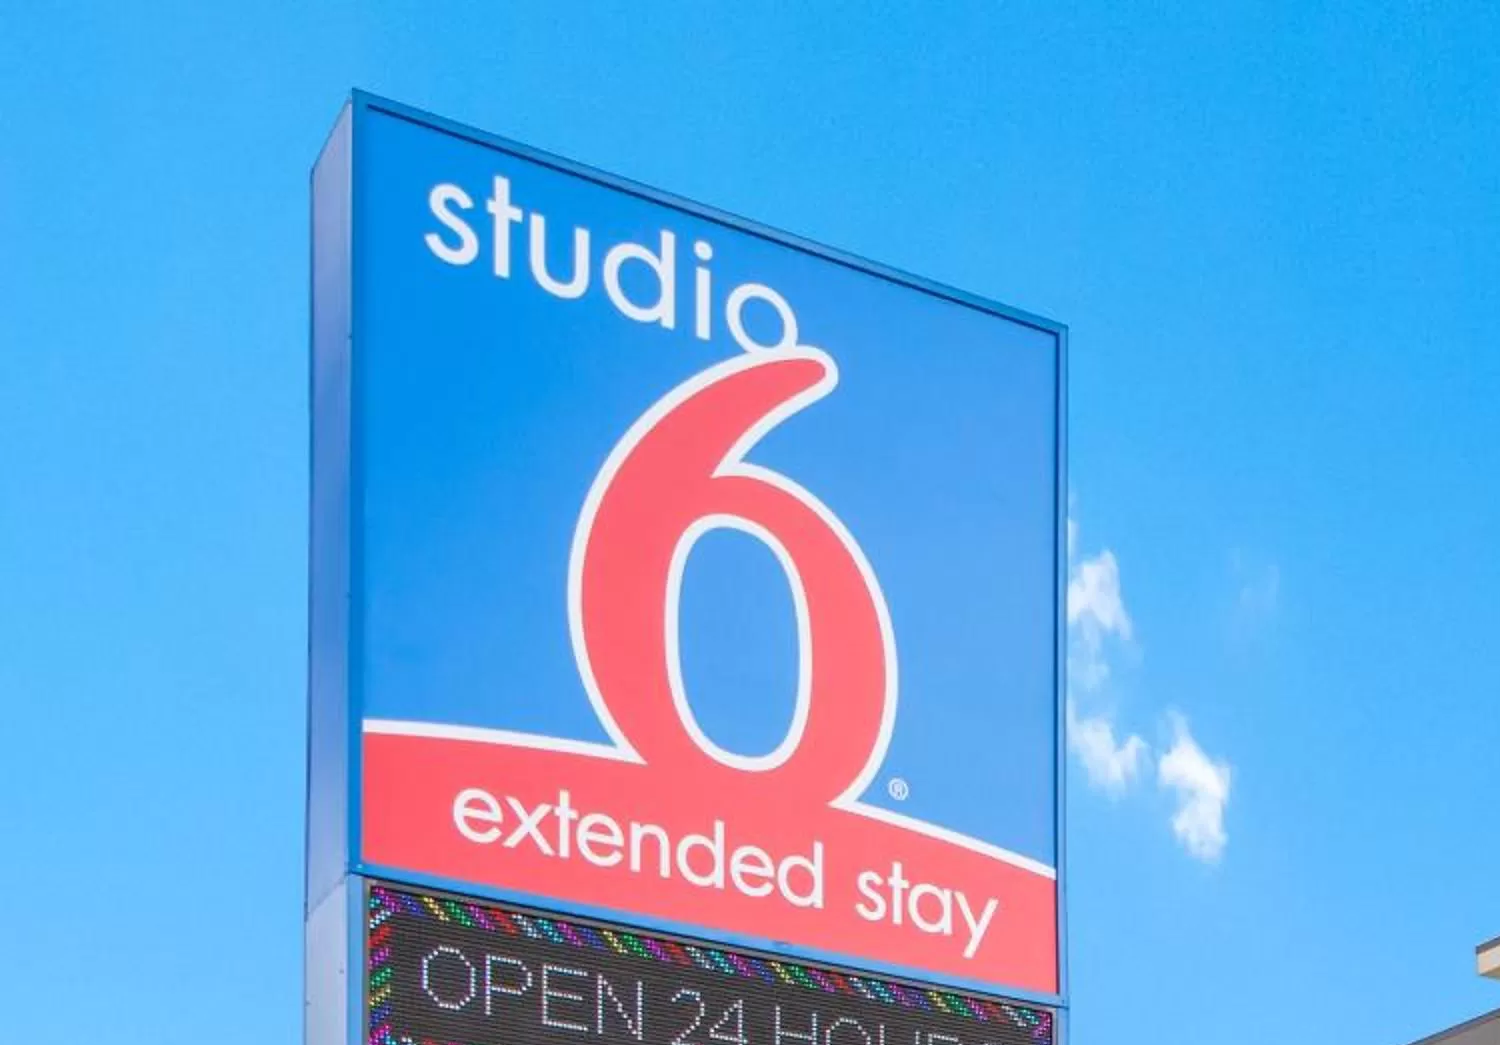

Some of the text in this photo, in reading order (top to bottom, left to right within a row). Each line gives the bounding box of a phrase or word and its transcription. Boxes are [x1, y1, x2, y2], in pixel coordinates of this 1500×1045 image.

[424, 175, 799, 354] studio
[567, 344, 898, 806] 6
[452, 786, 998, 958] extended stay
[420, 945, 645, 1041] OPEN
